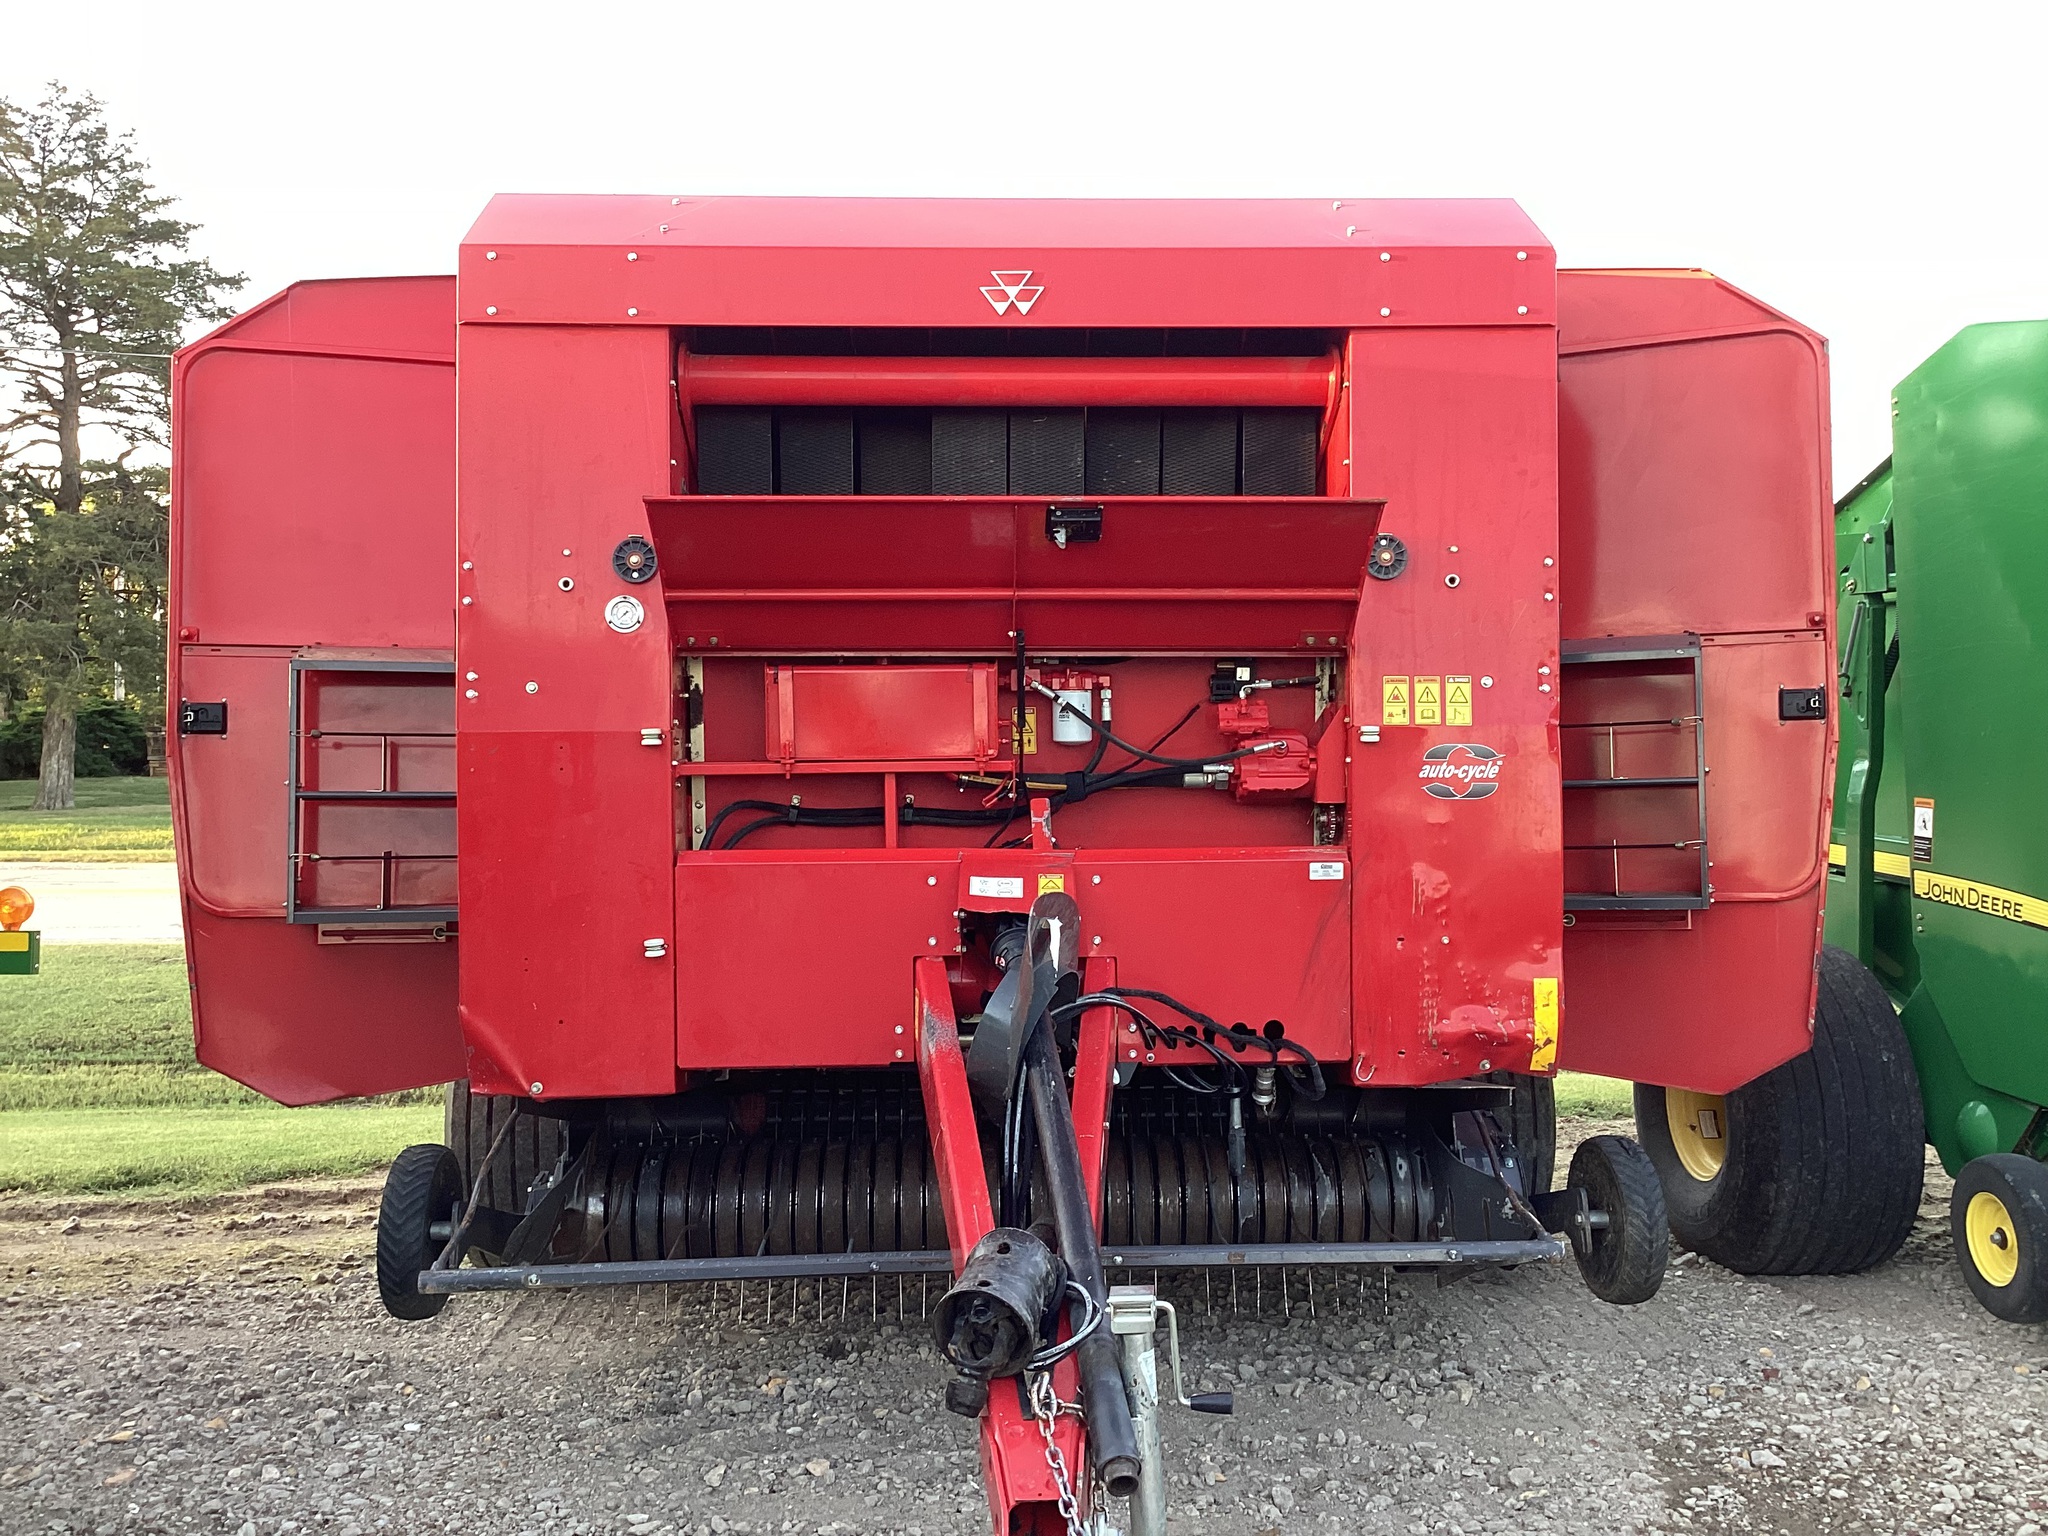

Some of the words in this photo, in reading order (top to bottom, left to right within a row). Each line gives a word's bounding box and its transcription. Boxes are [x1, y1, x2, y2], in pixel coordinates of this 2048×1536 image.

[1419, 761, 1500, 783] auto-cycle
[1923, 879, 1965, 904] JOHN
[1967, 888, 2023, 919] DEERE
